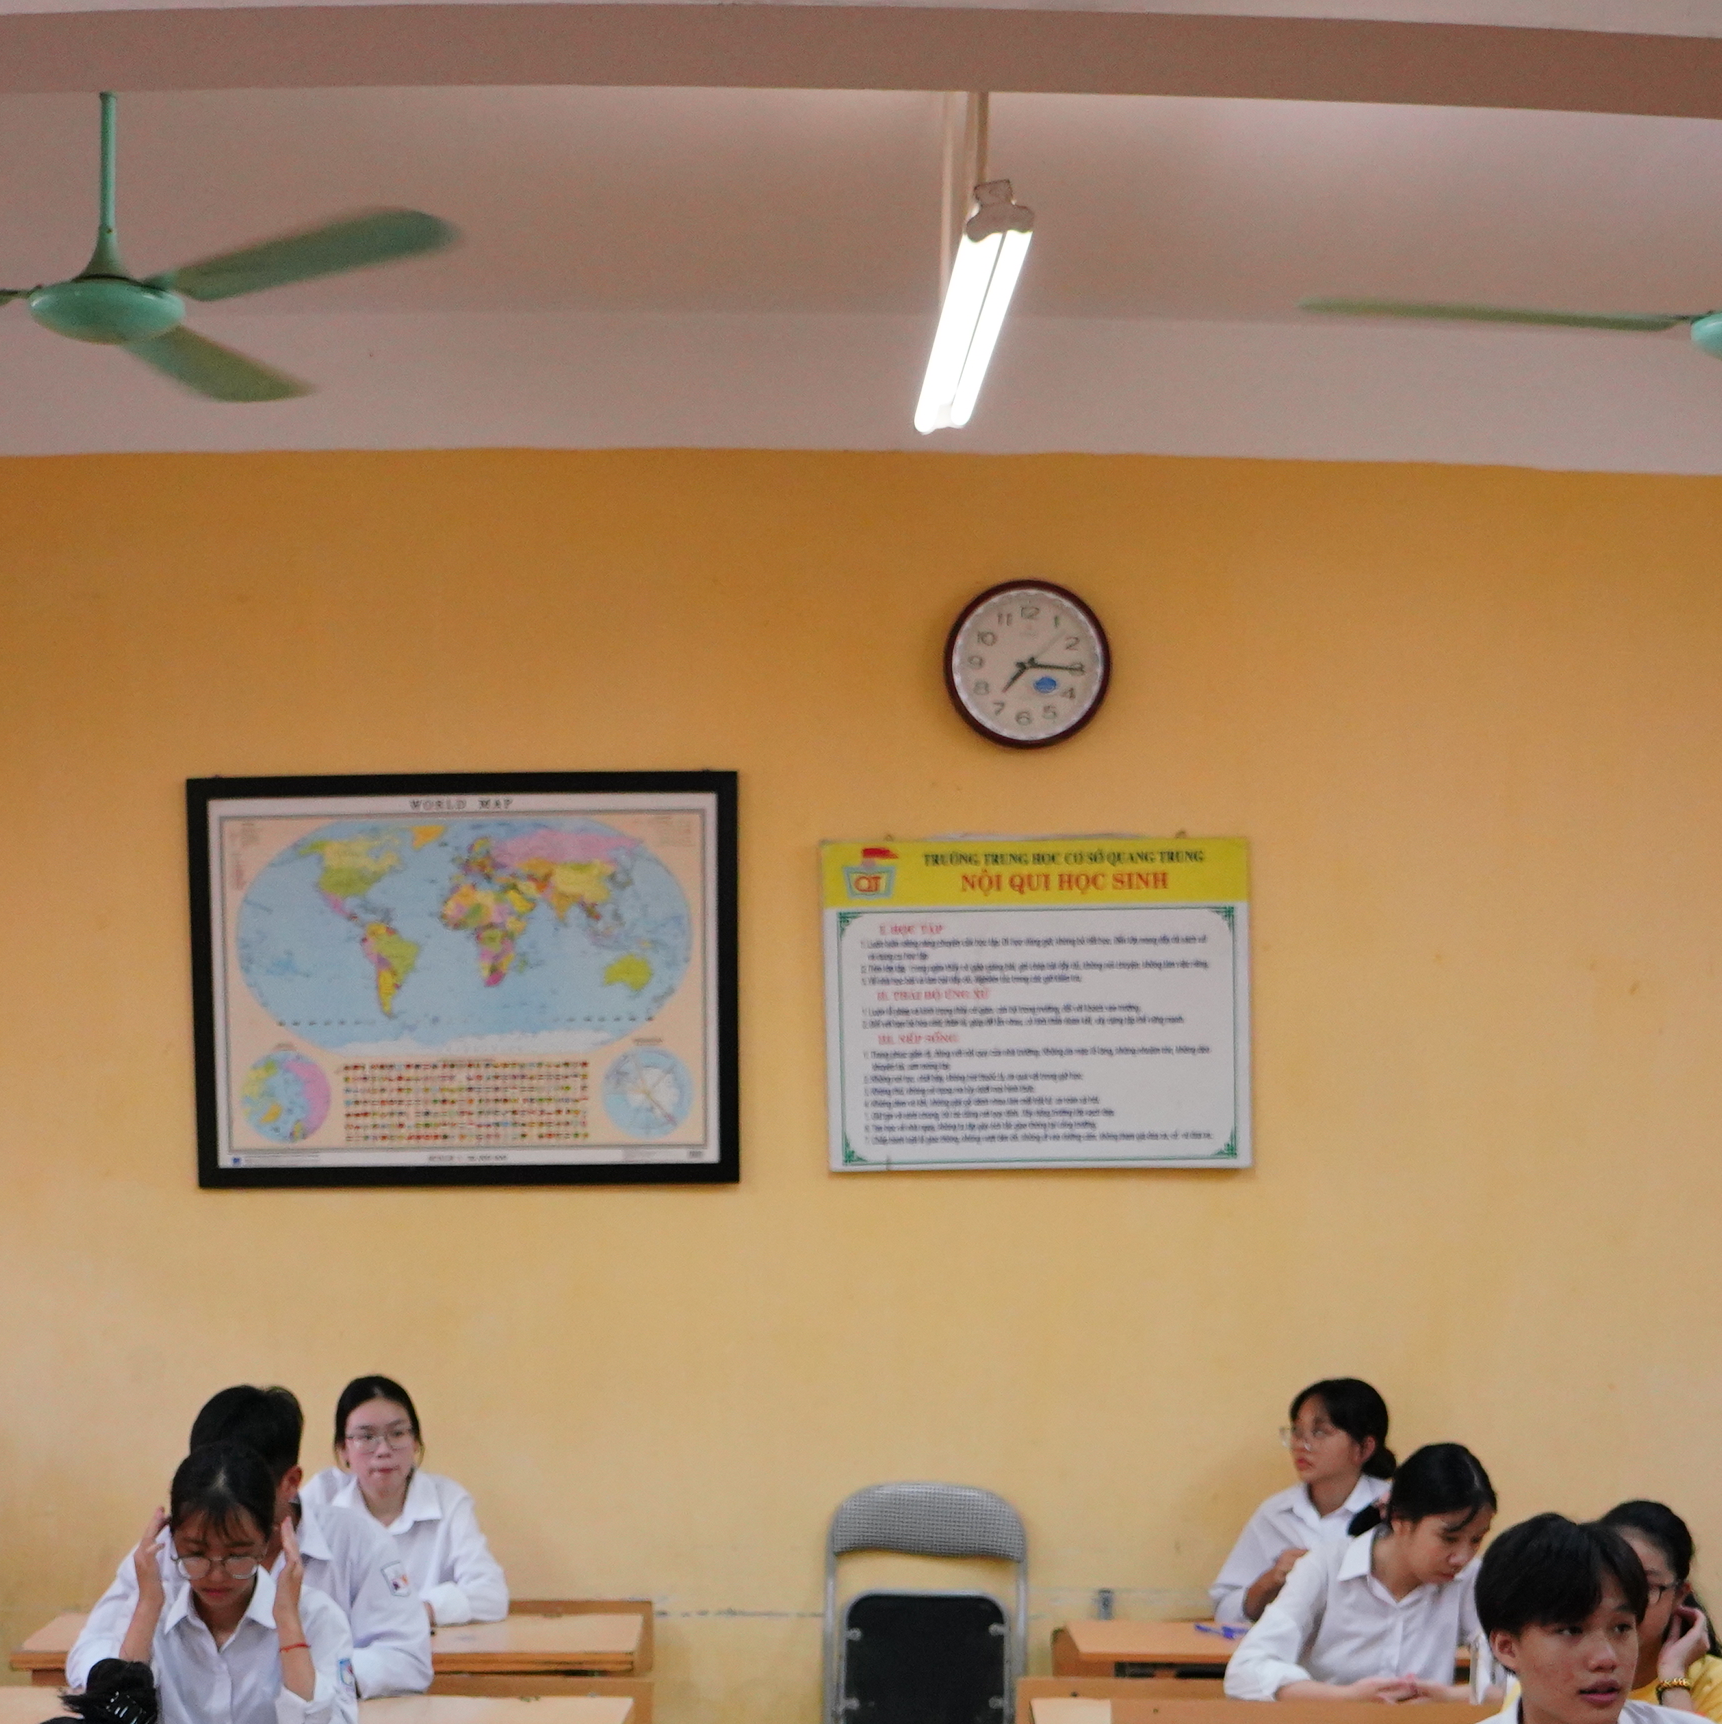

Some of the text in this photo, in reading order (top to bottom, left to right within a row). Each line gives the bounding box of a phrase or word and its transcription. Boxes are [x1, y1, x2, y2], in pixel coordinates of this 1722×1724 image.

[997, 612, 1014, 627] 11
[1020, 605, 1040, 619] 12
[1053, 615, 1060, 628] 1
[977, 631, 996, 647] 10
[1065, 636, 1080, 651] 2
[968, 654, 983, 669] 9
[973, 680, 990, 696] 8
[1061, 687, 1076, 700] 4
[993, 701, 1005, 716] 7
[1042, 704, 1057, 720] 5
[1015, 710, 1032, 726] 6
[409, 798, 514, 811] WORLD MAP
[1106, 850, 1156, 867] QUANG
[1159, 849, 1204, 863] TRUNG
[960, 868, 1169, 896] NỘI QUI HỌC SINH
